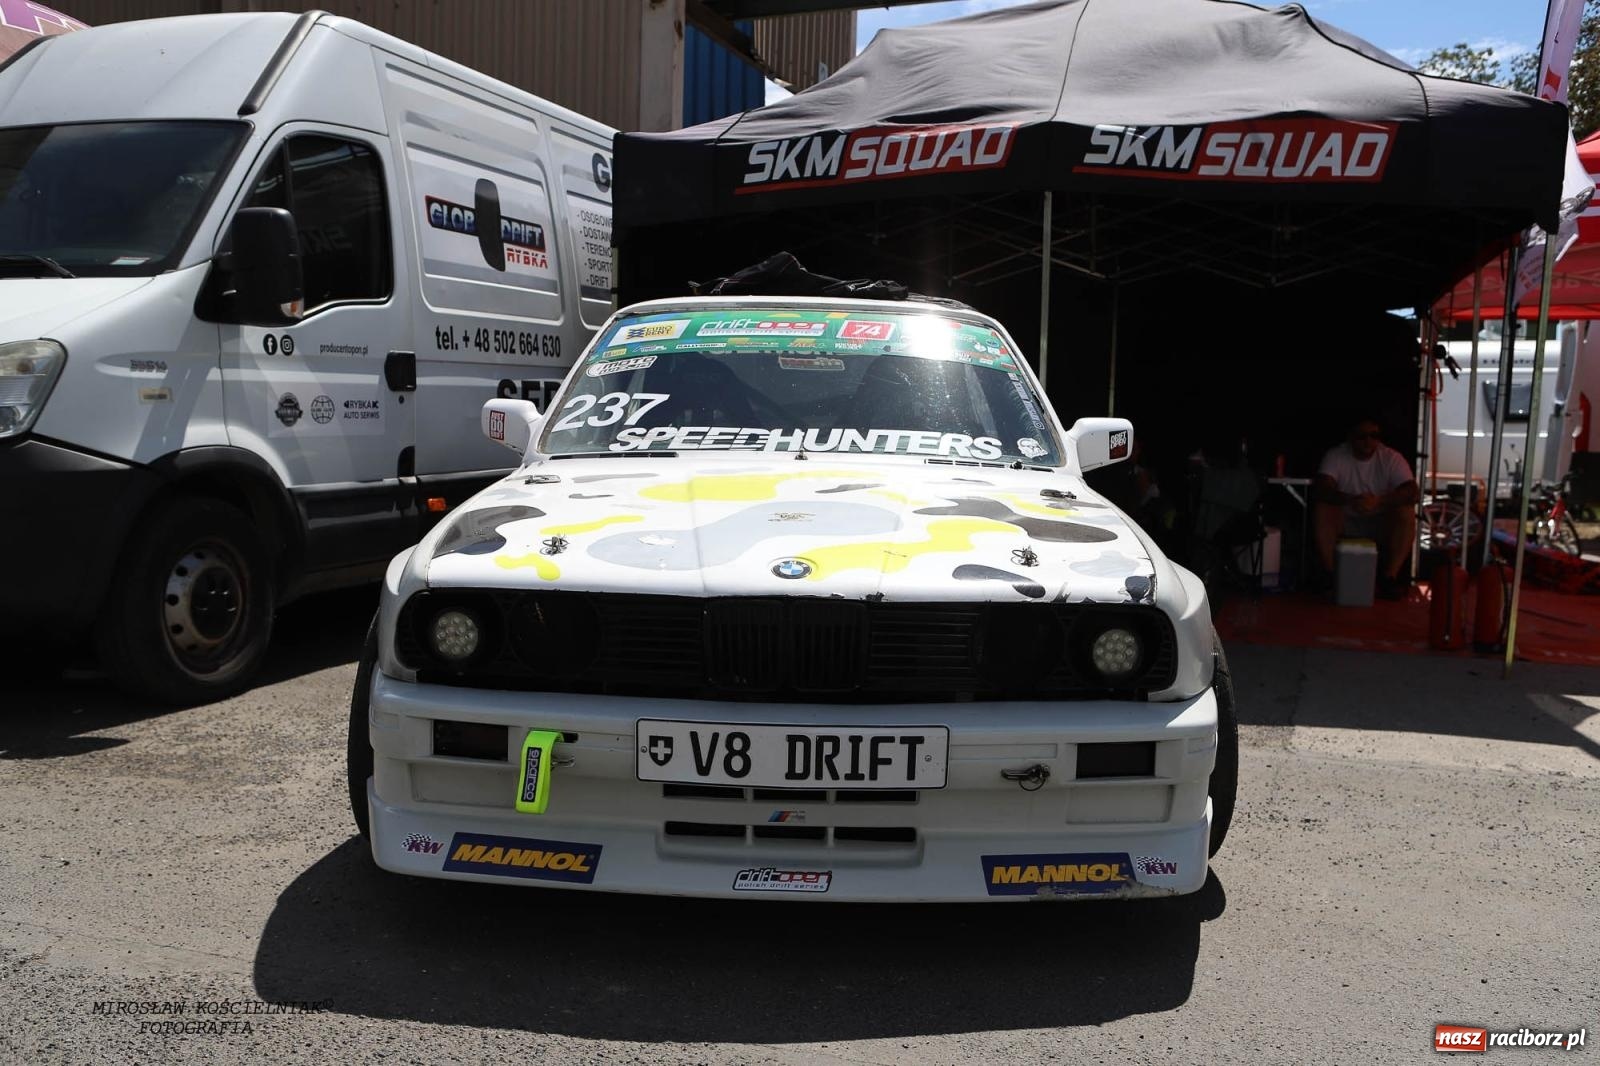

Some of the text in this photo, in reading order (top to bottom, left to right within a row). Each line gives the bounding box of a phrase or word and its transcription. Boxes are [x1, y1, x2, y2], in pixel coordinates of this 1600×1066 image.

[744, 126, 1015, 184] SKM SQUAD
[1083, 123, 1390, 177] SKM SQUAD
[506, 248, 549, 269] RYBKA
[590, 274, 609, 288] DRIFT
[435, 325, 459, 350] tel.
[474, 328, 490, 352] 48
[494, 329, 516, 354] 502
[519, 331, 539, 356] 664
[542, 334, 561, 358] 630
[854, 323, 880, 336] 74
[320, 342, 369, 355] producentopon.pl
[343, 411, 380, 420] AUTO SERWIS
[552, 392, 671, 433] 237
[609, 425, 1003, 460] SPEEDHUNTERS
[690, 731, 925, 781] V8 DRIFT
[525, 749, 540, 801] sparco
[407, 840, 444, 855] KW
[452, 843, 591, 873] MANNOL
[991, 863, 1130, 884] MANNOL
[1146, 861, 1178, 875] KW
